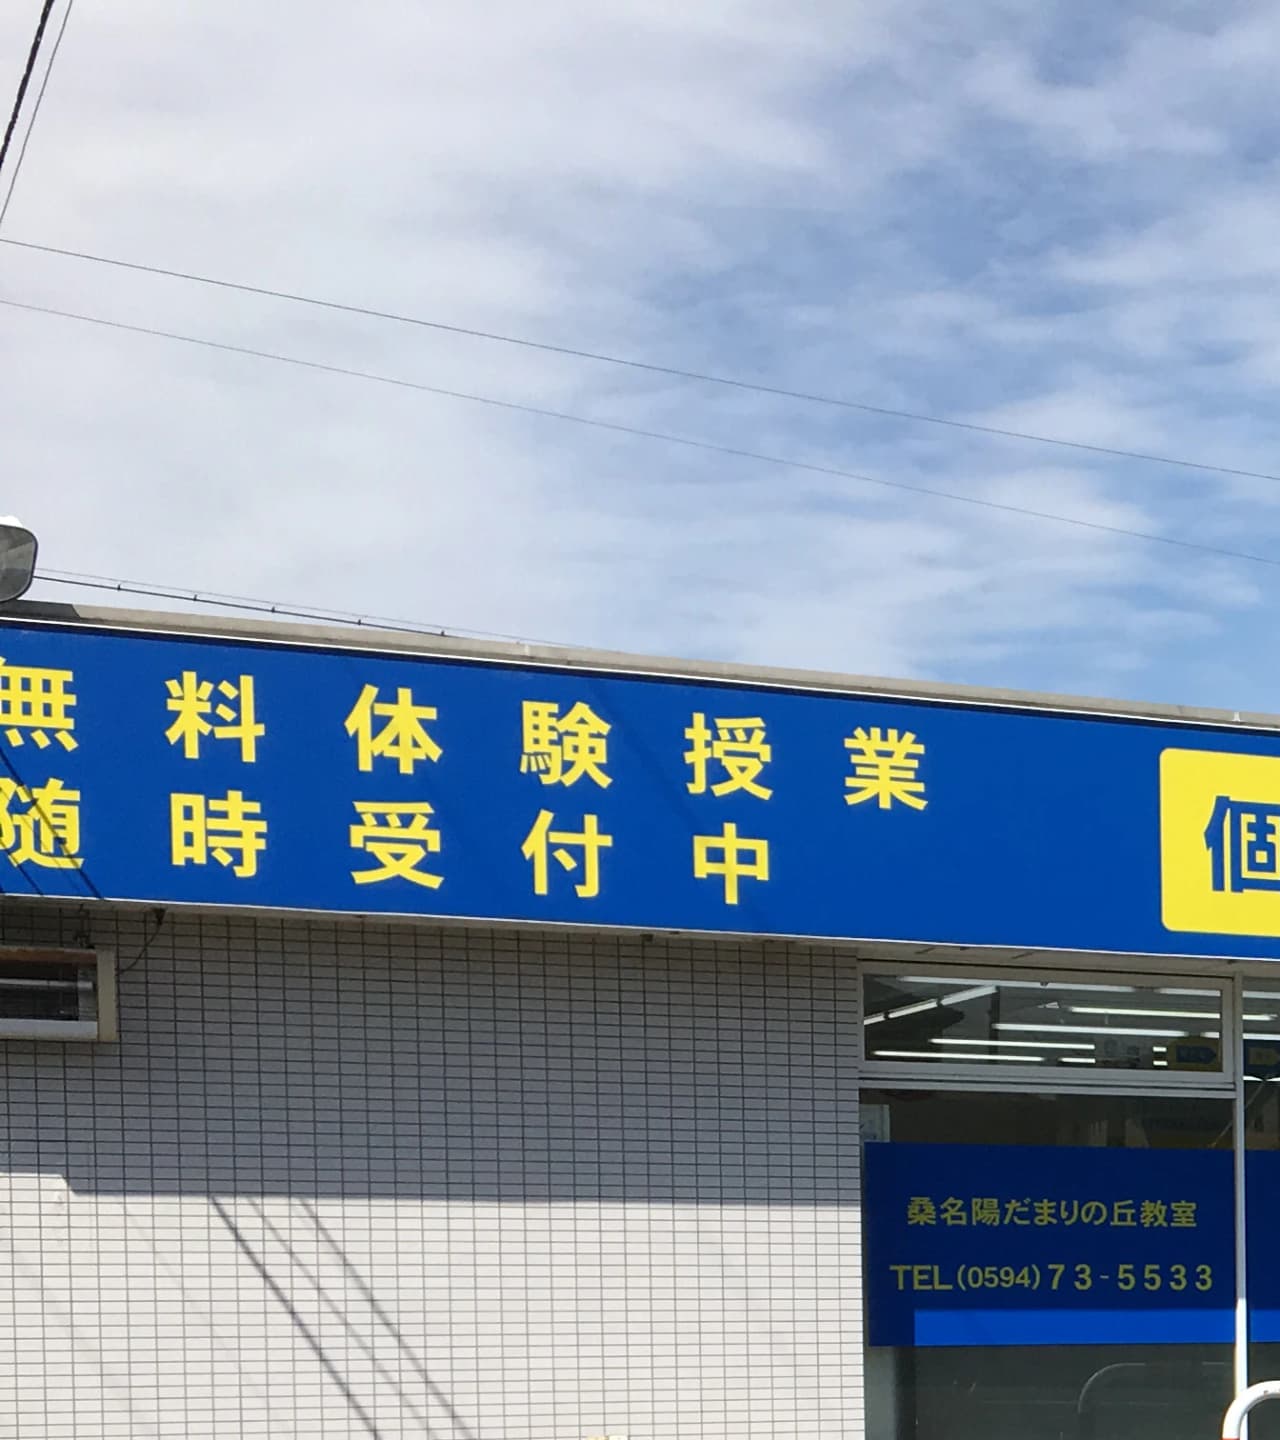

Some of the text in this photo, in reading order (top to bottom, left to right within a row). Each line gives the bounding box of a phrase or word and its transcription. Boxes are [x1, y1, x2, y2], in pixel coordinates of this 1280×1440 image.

[0, 656, 928, 812] 無料体験授業
[0, 777, 770, 907] 随時受付中
[907, 1196, 1198, 1228] 桑名陽だまりの丘教室
